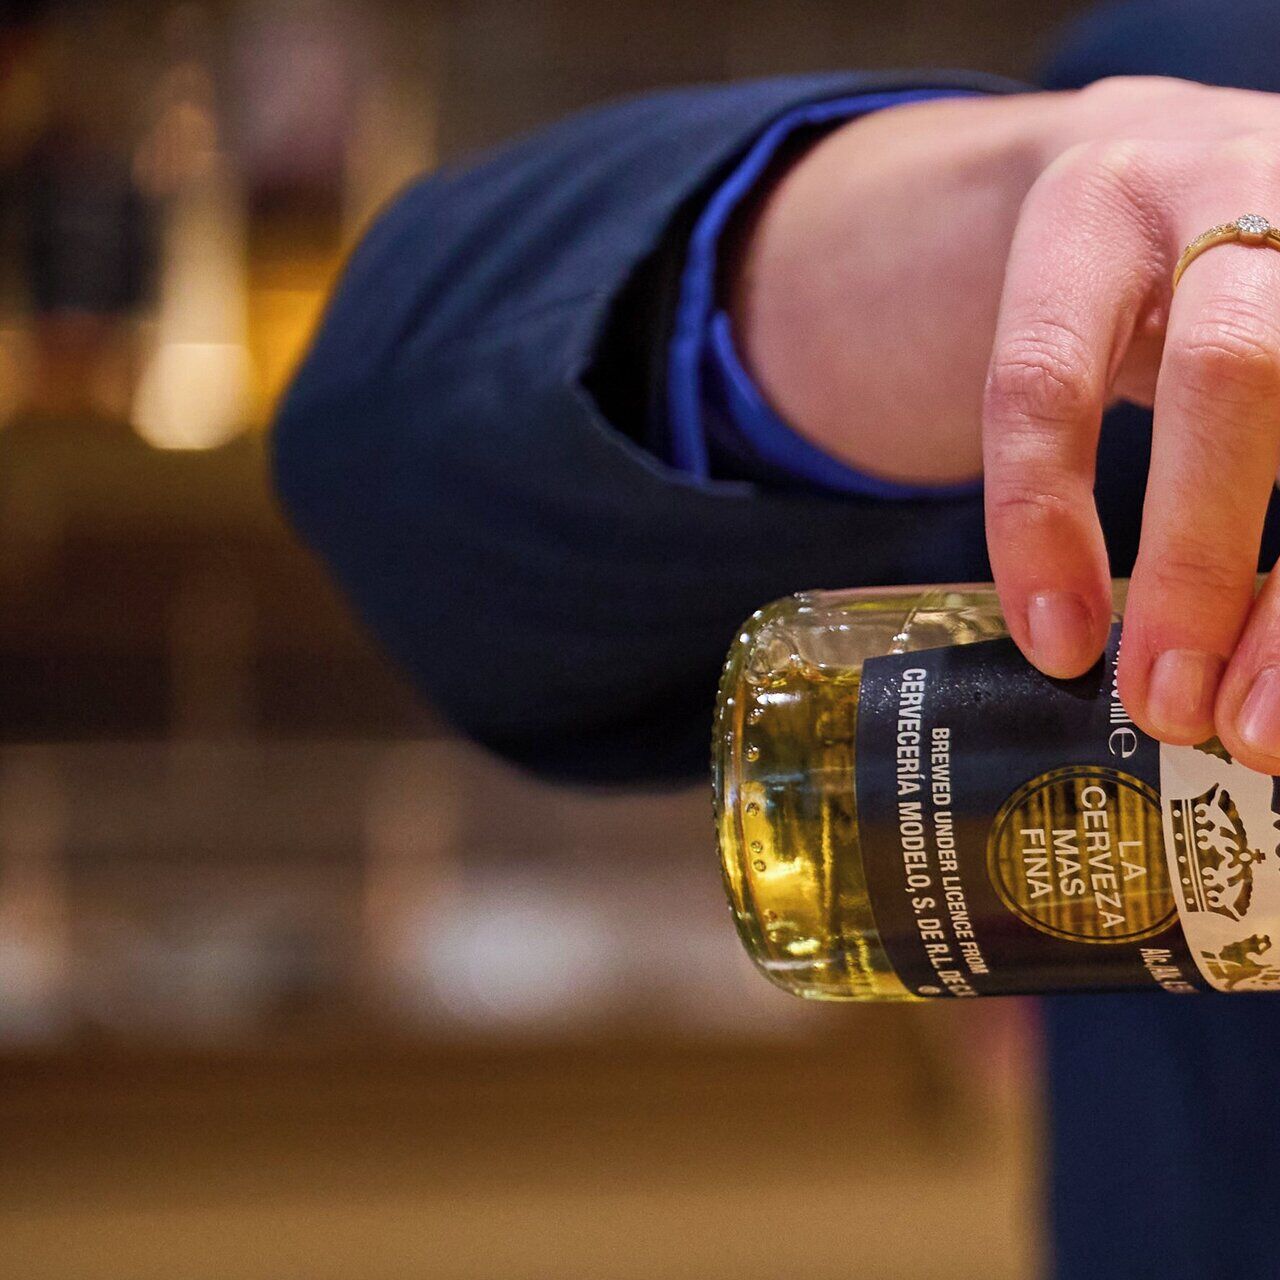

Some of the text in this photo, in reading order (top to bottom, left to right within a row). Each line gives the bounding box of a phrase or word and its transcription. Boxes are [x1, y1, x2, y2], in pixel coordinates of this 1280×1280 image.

[896, 668, 927, 796] CERVECERÍA
[898, 801, 932, 893] MODELO,
[931, 727, 989, 974] BREWED UNDER LICENCE FROM
[1020, 828, 1053, 899] FINA
[1052, 829, 1086, 896] MAS
[1081, 785, 1125, 928] CERVEZA
[1118, 841, 1147, 881] LA
[911, 897, 936, 914] S.
[917, 918, 945, 940] DE
